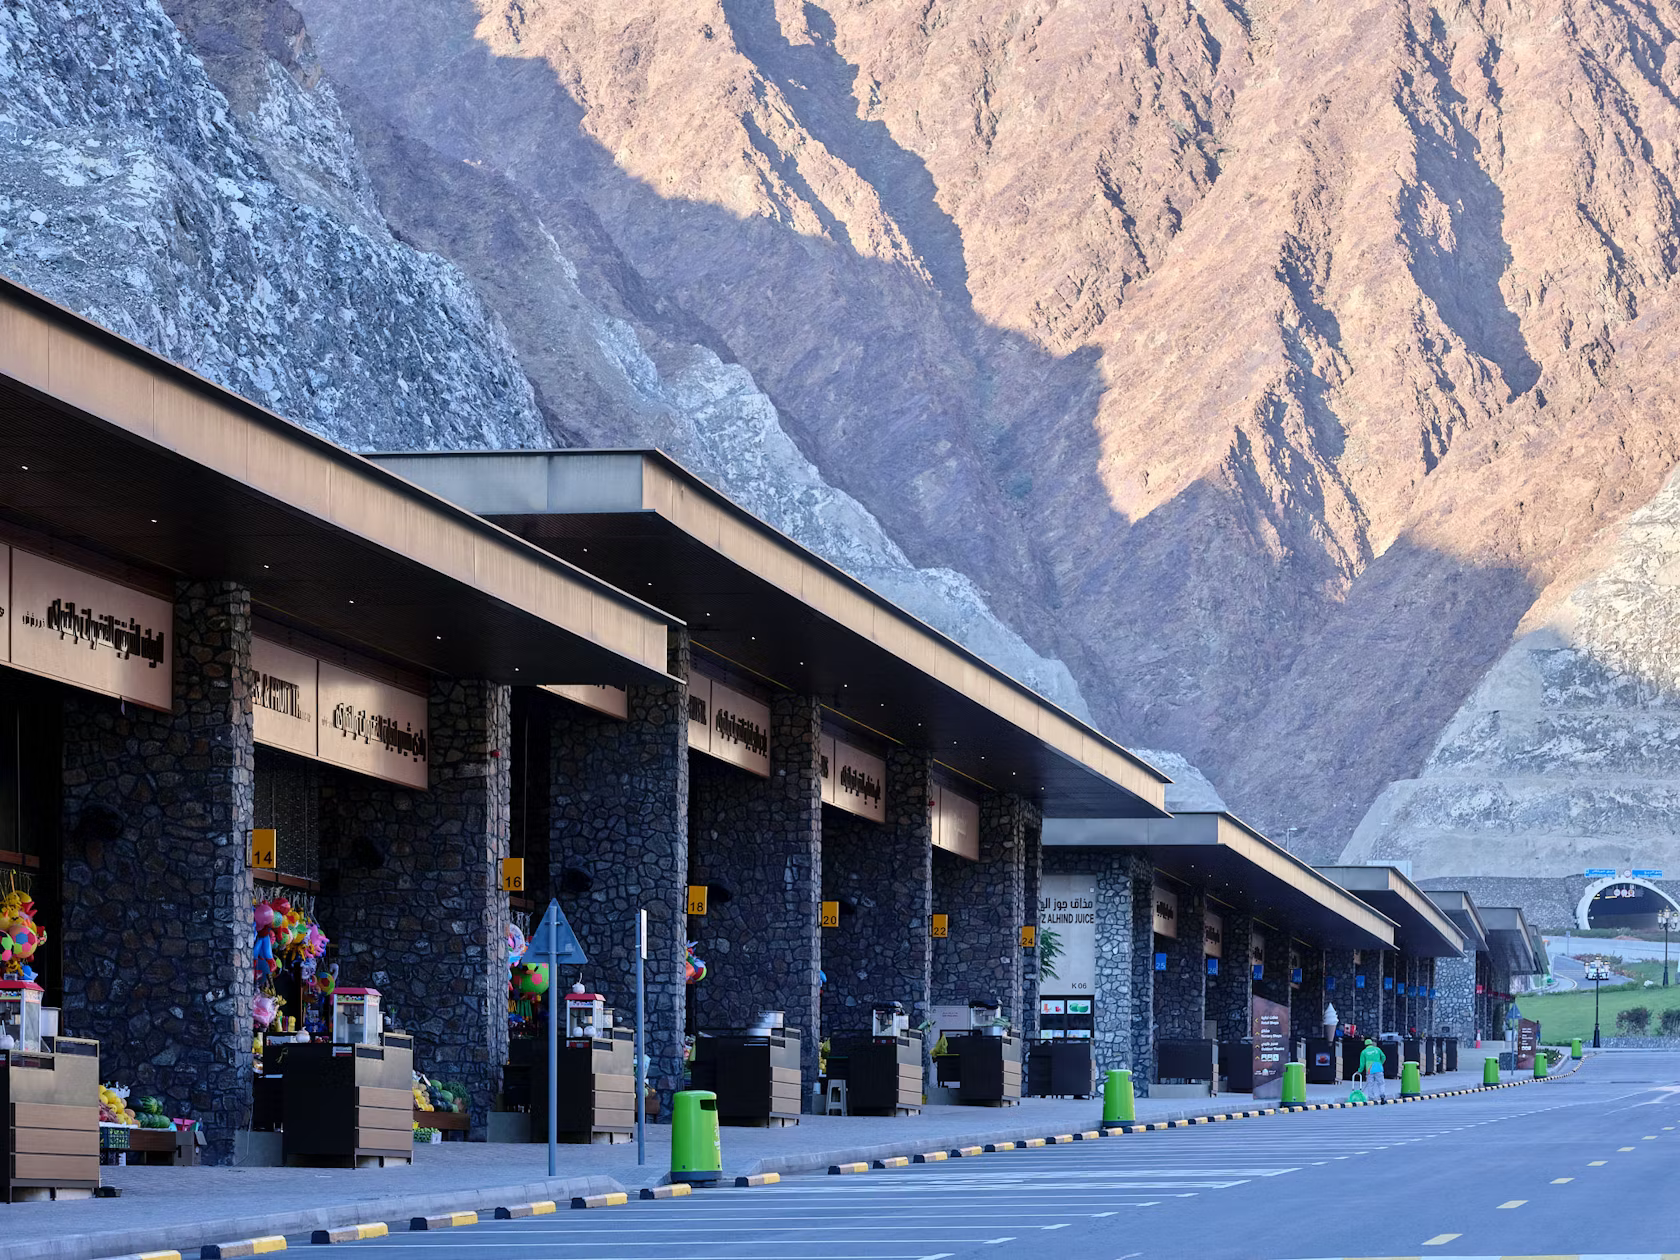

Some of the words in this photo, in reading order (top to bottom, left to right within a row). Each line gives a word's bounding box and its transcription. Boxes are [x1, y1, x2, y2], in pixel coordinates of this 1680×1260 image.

[253, 850, 273, 865] 14
[505, 876, 522, 888] 16
[689, 901, 704, 912] 18
[822, 915, 837, 925] 20
[1041, 913, 1046, 924] Z
[1047, 913, 1074, 924] ALHIND
[1074, 913, 1095, 924] JUICE
[933, 926, 946, 936] 22
[1022, 937, 1033, 945] 24
[1155, 962, 1166, 970] 25
